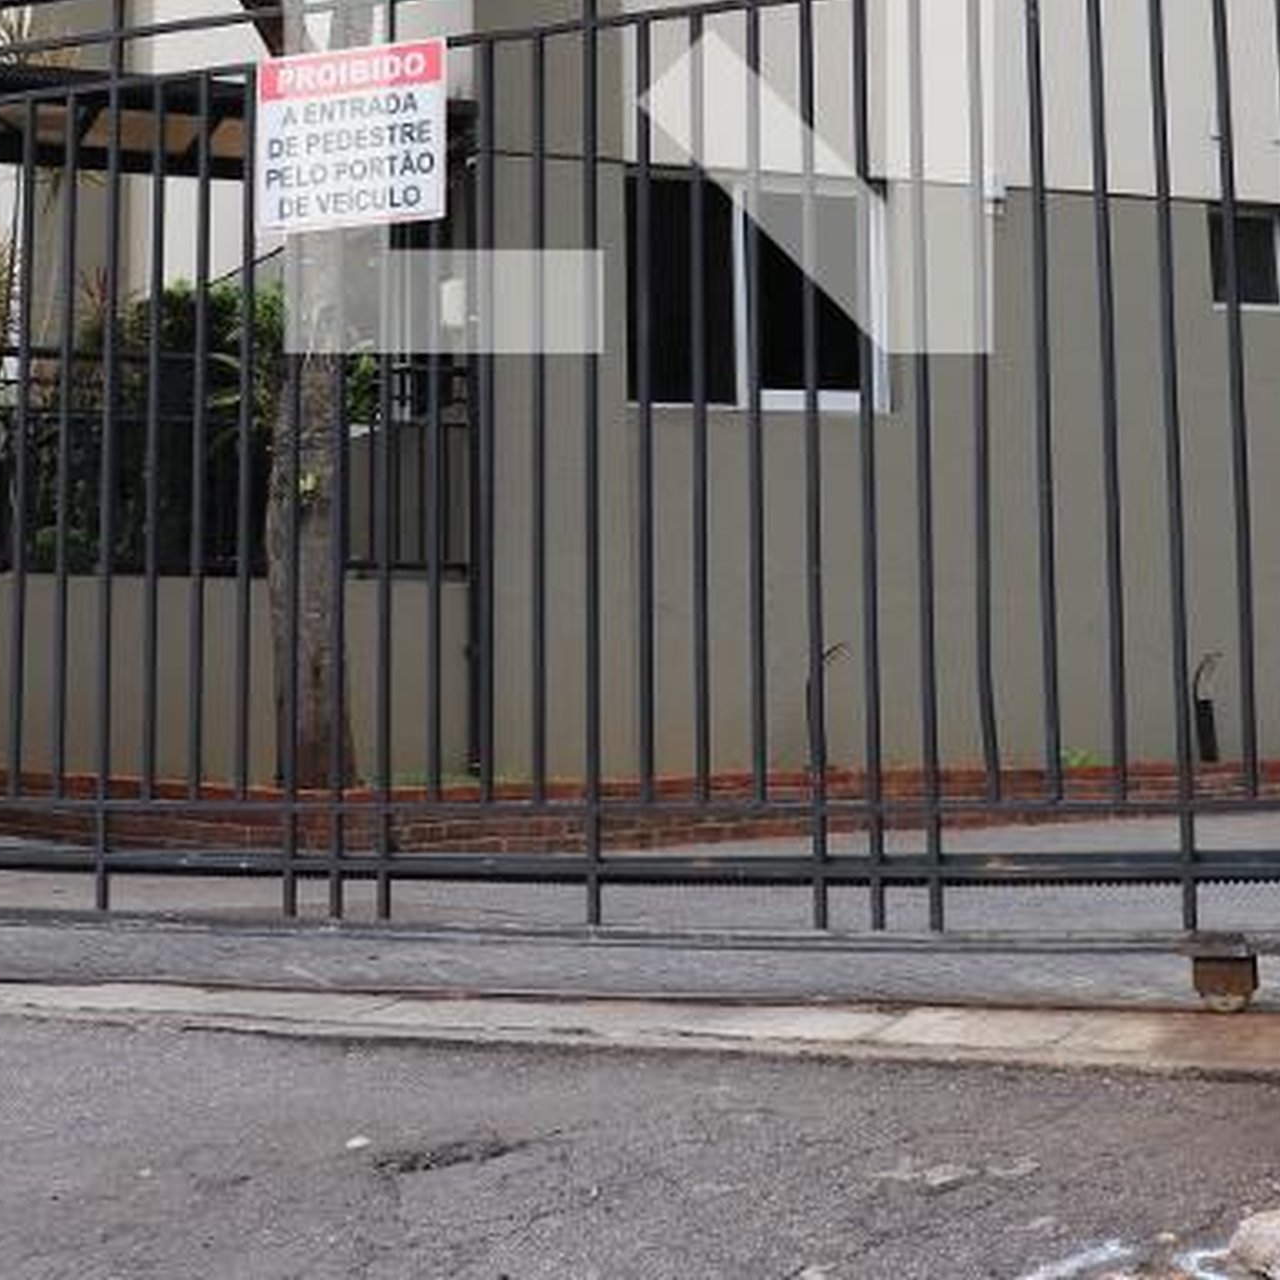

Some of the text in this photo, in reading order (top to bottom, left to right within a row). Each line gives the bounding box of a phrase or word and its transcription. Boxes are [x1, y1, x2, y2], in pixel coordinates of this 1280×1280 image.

[276, 53, 426, 93] PROIBIDO
[282, 92, 418, 124] A ENTRADA
[269, 120, 432, 160] DE PEDESTRE
[266, 150, 435, 188] PELO PORTÃO
[279, 185, 421, 219] DE VEÍCULO
